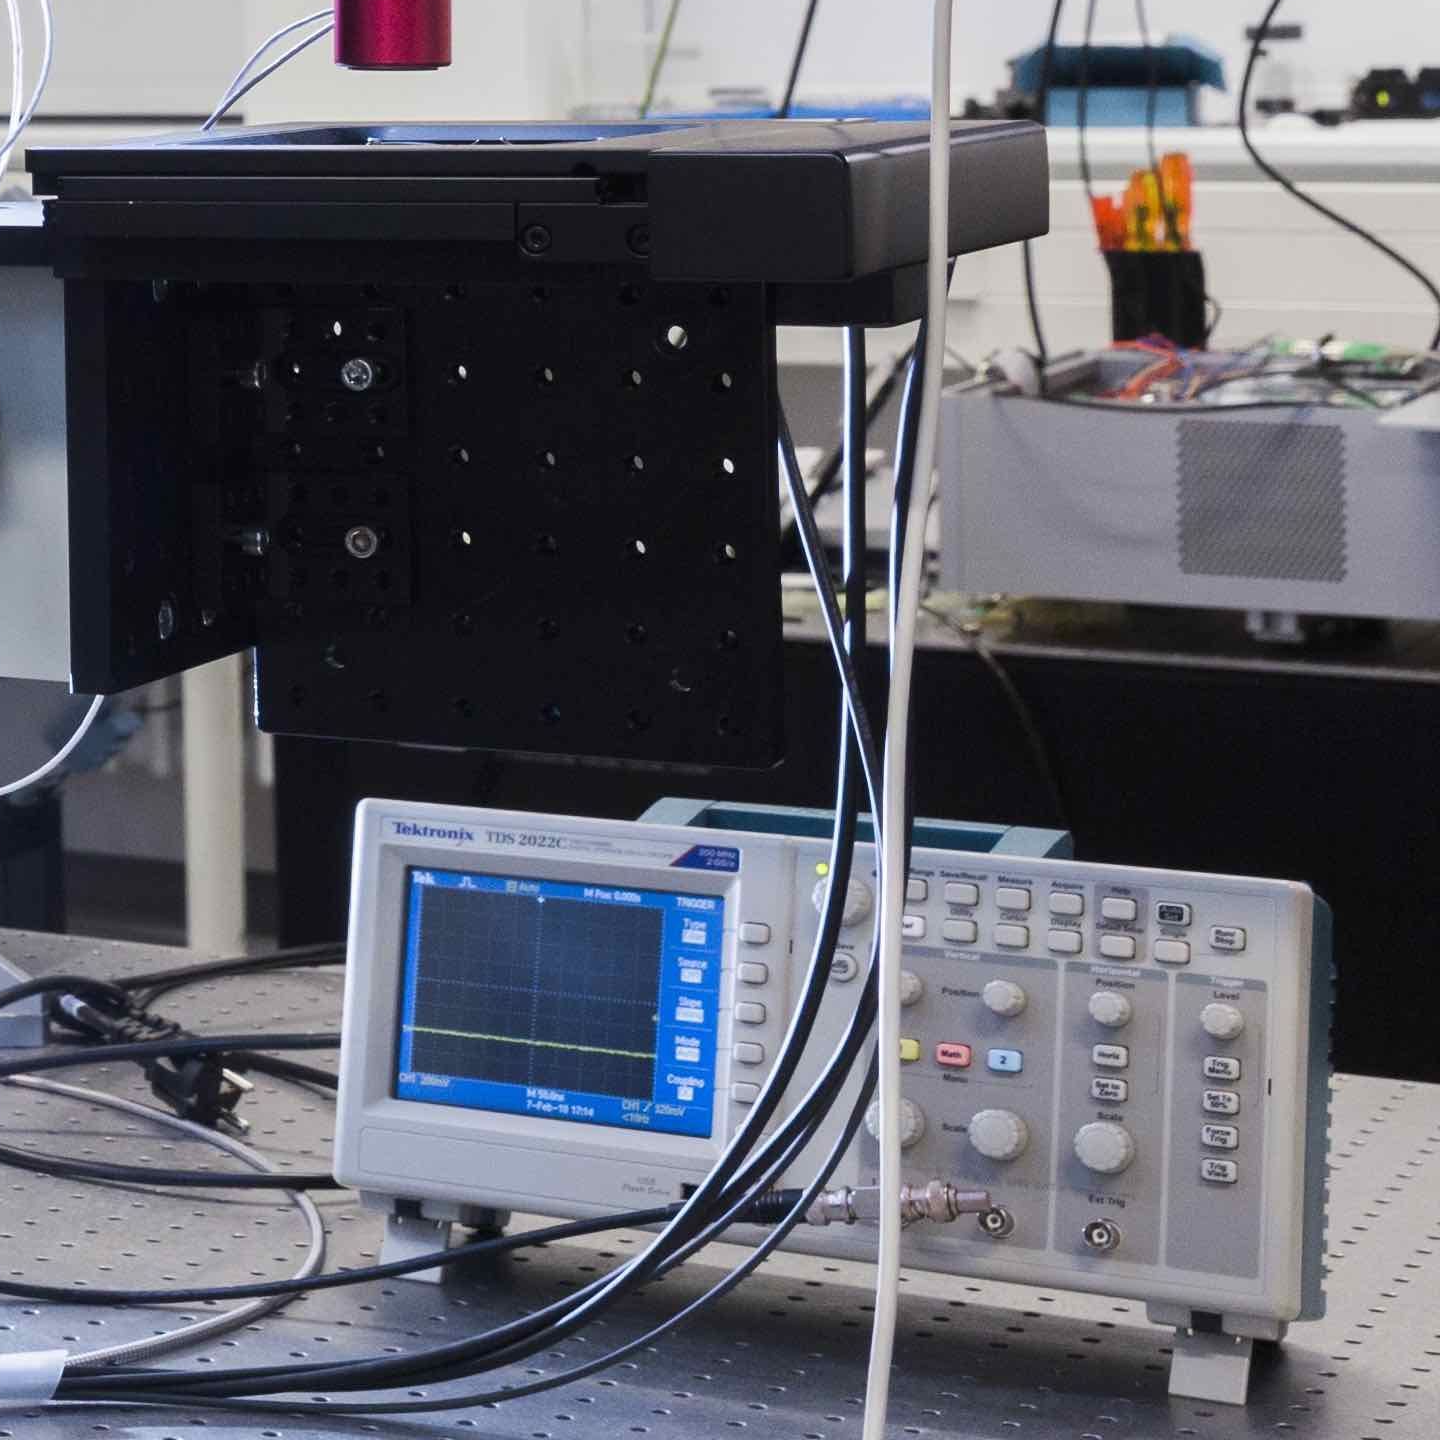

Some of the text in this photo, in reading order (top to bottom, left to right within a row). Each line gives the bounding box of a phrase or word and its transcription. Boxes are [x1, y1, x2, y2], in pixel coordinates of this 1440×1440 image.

[391, 820, 475, 847] Tektronix
[485, 830, 515, 845] TDS
[518, 832, 567, 850] 2022C
[1095, 978, 1136, 990] Position
[1213, 990, 1241, 1002] Level
[940, 1049, 962, 1060] Math
[999, 1055, 1007, 1066] 2
[1211, 1059, 1230, 1069] Trig
[943, 1073, 969, 1084] Menu
[1096, 1111, 1123, 1123] Scale
[1209, 1134, 1228, 1145] Trig
[1209, 1162, 1228, 1172] Trig
[1109, 1197, 1126, 1209] Trig
